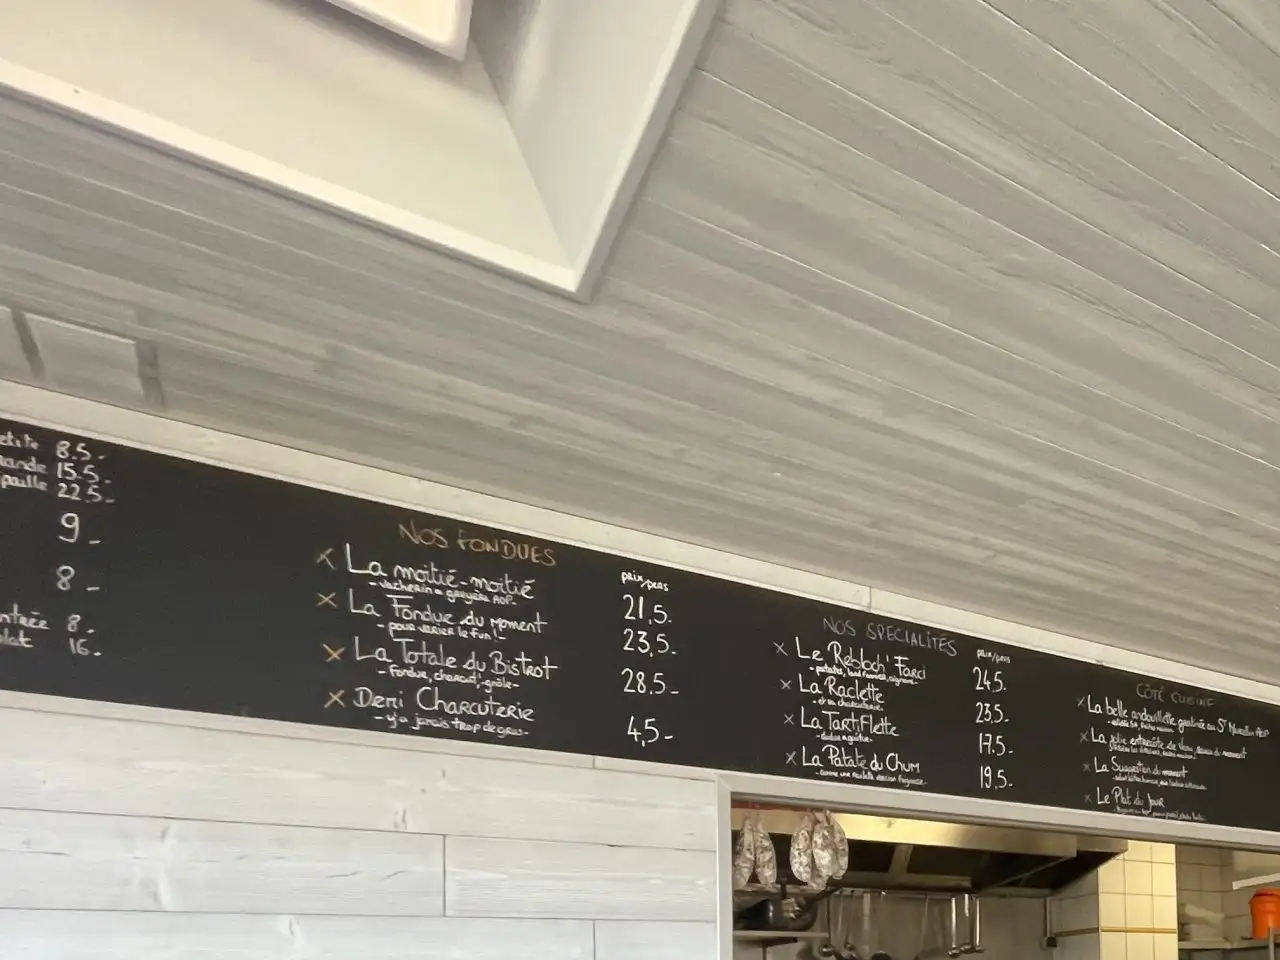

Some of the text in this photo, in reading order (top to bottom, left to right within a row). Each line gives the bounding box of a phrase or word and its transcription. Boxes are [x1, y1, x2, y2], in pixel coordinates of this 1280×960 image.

[398, 518, 556, 566] NOS FONDUES
[346, 542, 388, 577] La
[350, 588, 382, 617] La
[460, 610, 484, 627] du
[0, 627, 34, 648] lat
[822, 617, 857, 637] NOS
[354, 636, 392, 662] La
[393, 638, 457, 668] Totale
[462, 651, 487, 672] du
[795, 636, 824, 661] Le
[798, 673, 884, 703] La Raclette
[1088, 694, 1103, 714] La
[800, 706, 823, 729] La
[1091, 727, 1107, 745] La
[802, 745, 824, 766] La
[822, 744, 868, 769] Patate
[870, 753, 883, 771] du
[1094, 755, 1109, 773] La
[1097, 786, 1110, 804] Le
